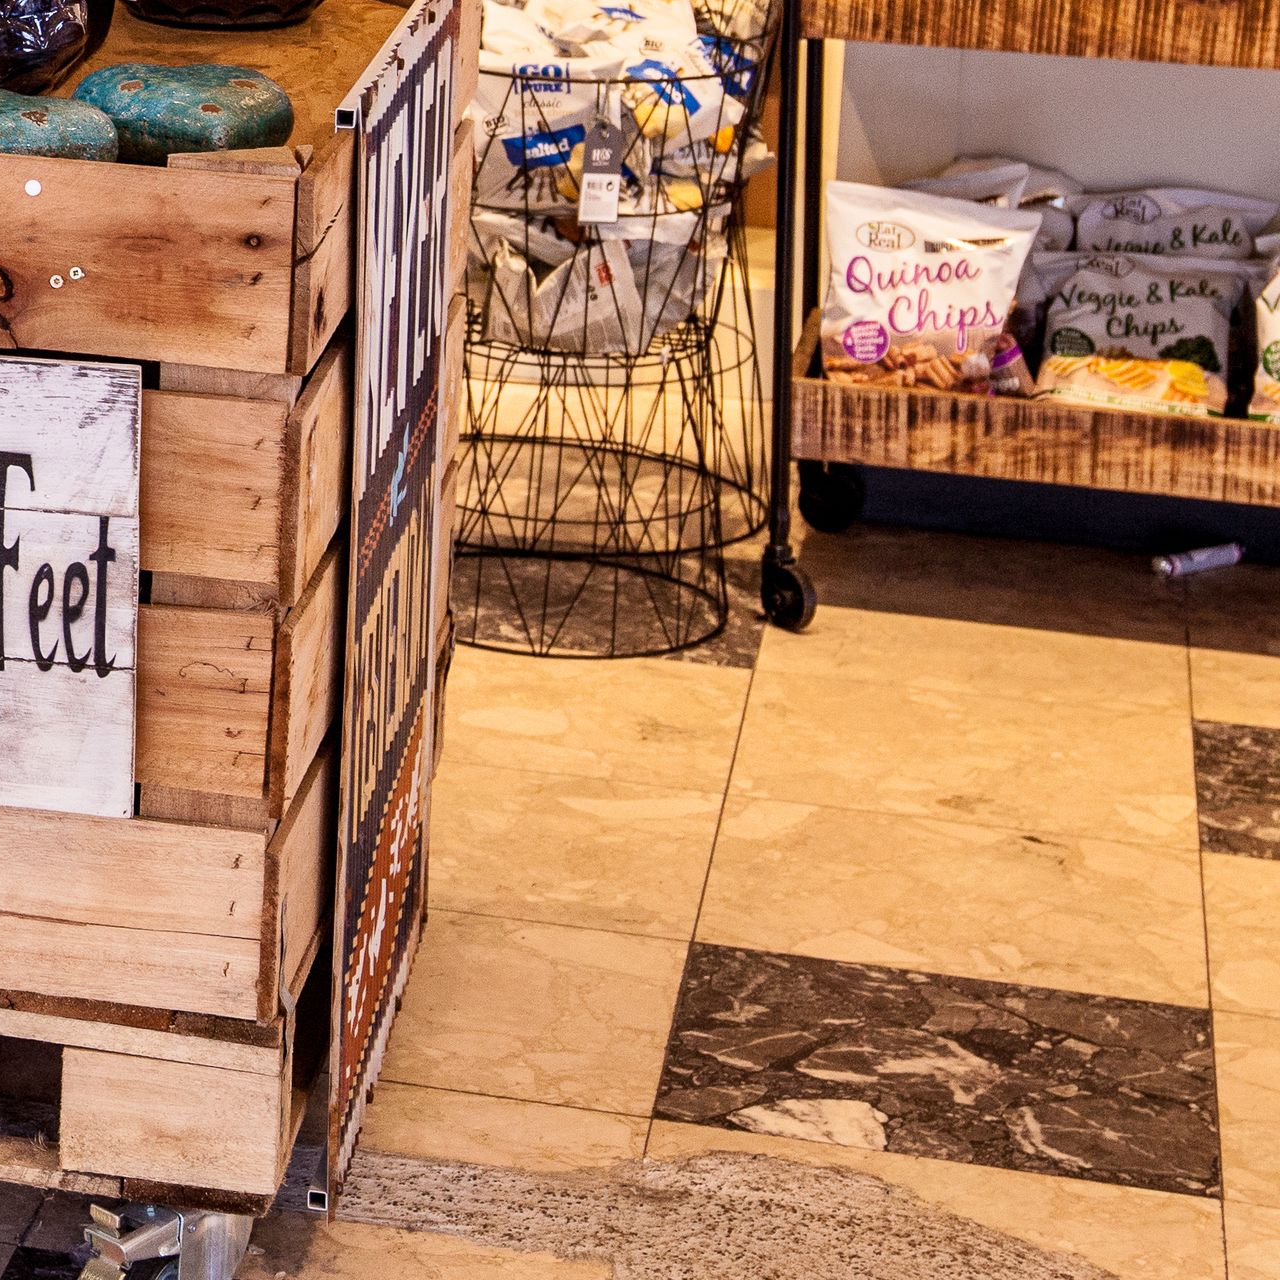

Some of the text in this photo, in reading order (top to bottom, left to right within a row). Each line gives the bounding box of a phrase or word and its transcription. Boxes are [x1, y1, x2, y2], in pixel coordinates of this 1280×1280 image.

[518, 63, 563, 80] GO
[523, 98, 562, 111] classic
[525, 139, 570, 160] salted
[867, 232, 902, 249] Real
[1168, 217, 1243, 251] & Kale
[846, 255, 981, 297] Quinoa
[1058, 279, 1224, 315] Veggie & Kale
[888, 288, 1004, 352] Chips
[1105, 313, 1185, 347] Chips
